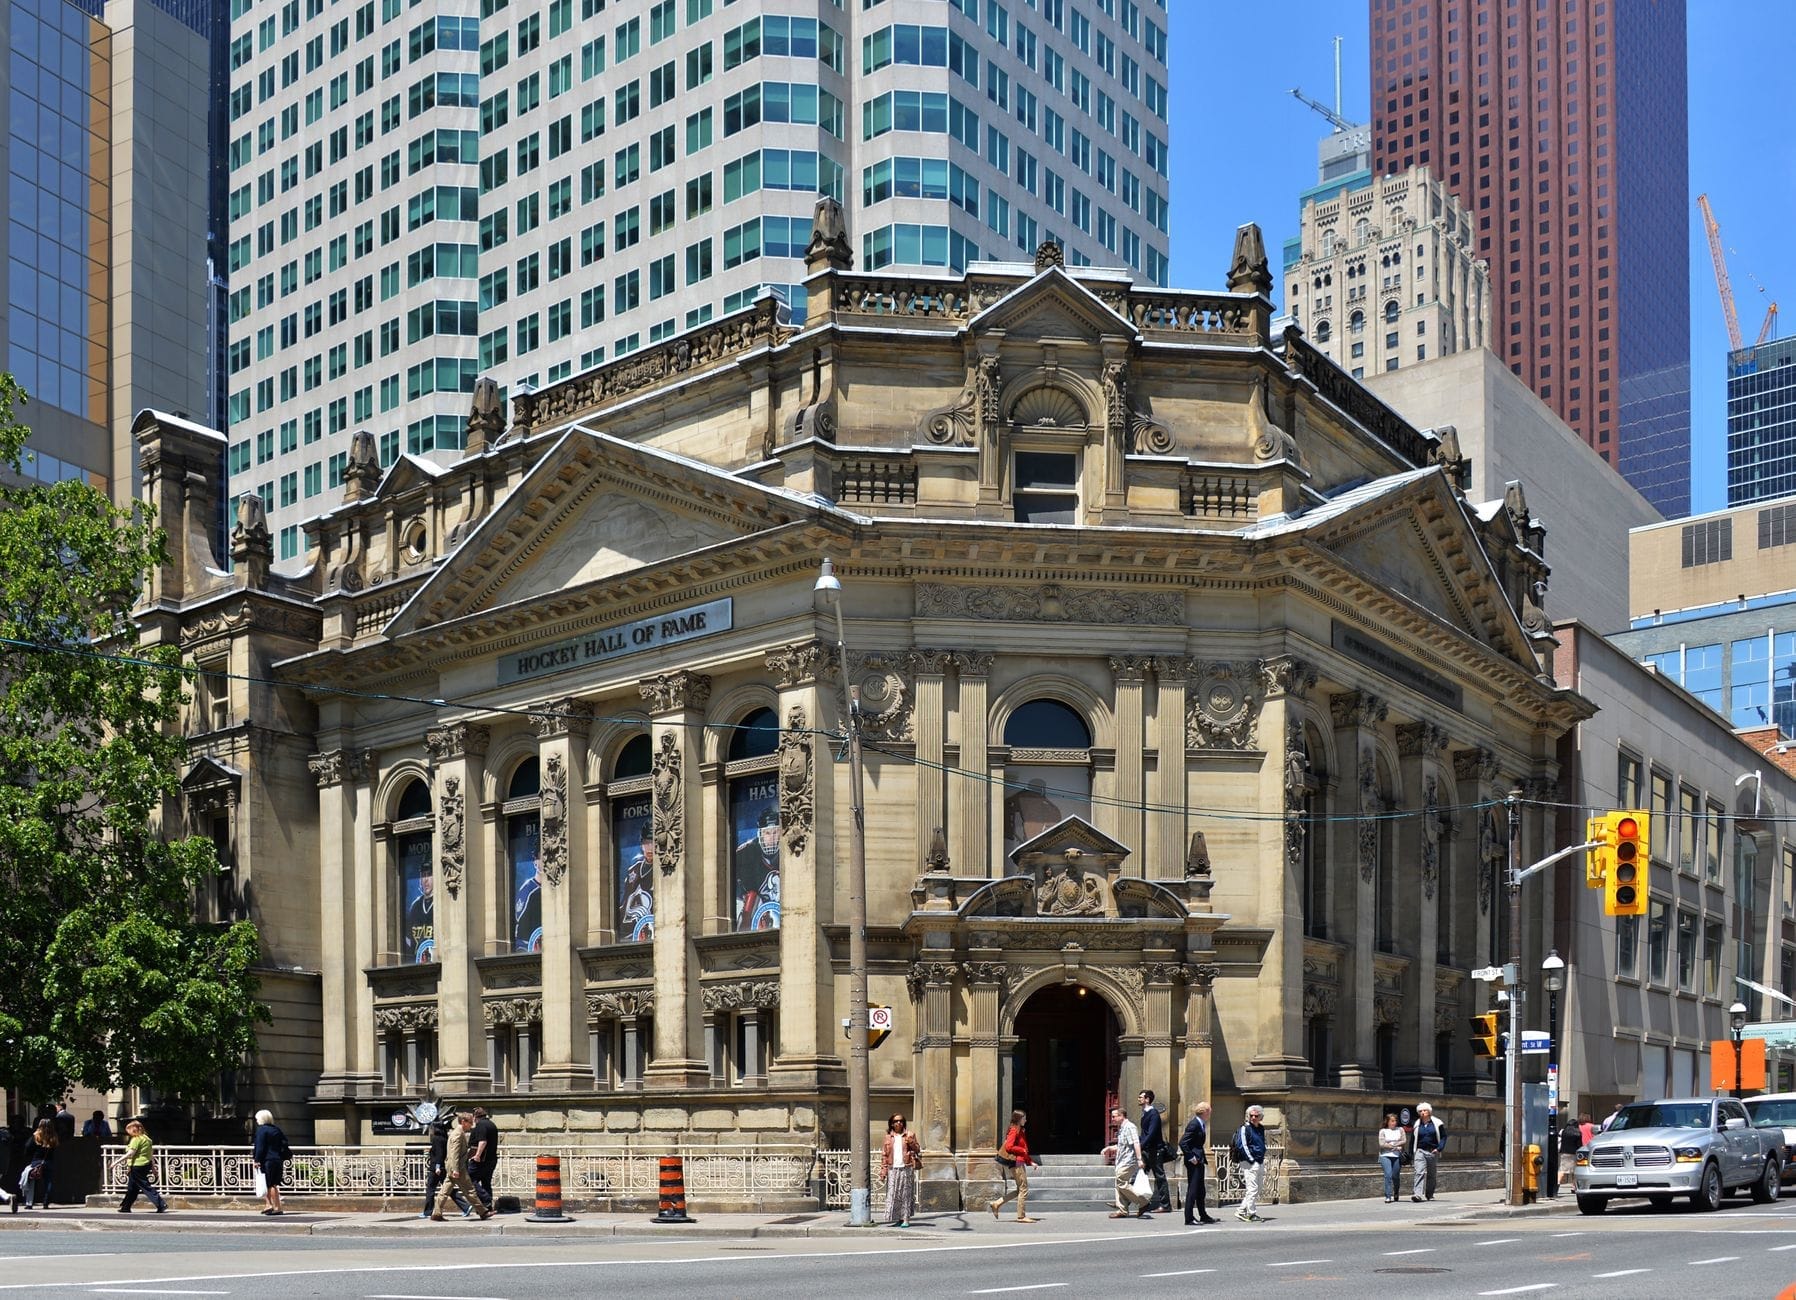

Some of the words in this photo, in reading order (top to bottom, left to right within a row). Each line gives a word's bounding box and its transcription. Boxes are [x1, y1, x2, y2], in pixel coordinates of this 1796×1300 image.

[1339, 132, 1371, 152] TR
[517, 644, 579, 675] HOCKEY
[584, 632, 627, 658] HALL
[632, 624, 656, 645] OF
[661, 611, 707, 638] FAME
[525, 823, 538, 837] BL
[408, 842, 431, 856] MOD
[412, 924, 433, 938] STAR
[1473, 969, 1491, 977] FRONT
